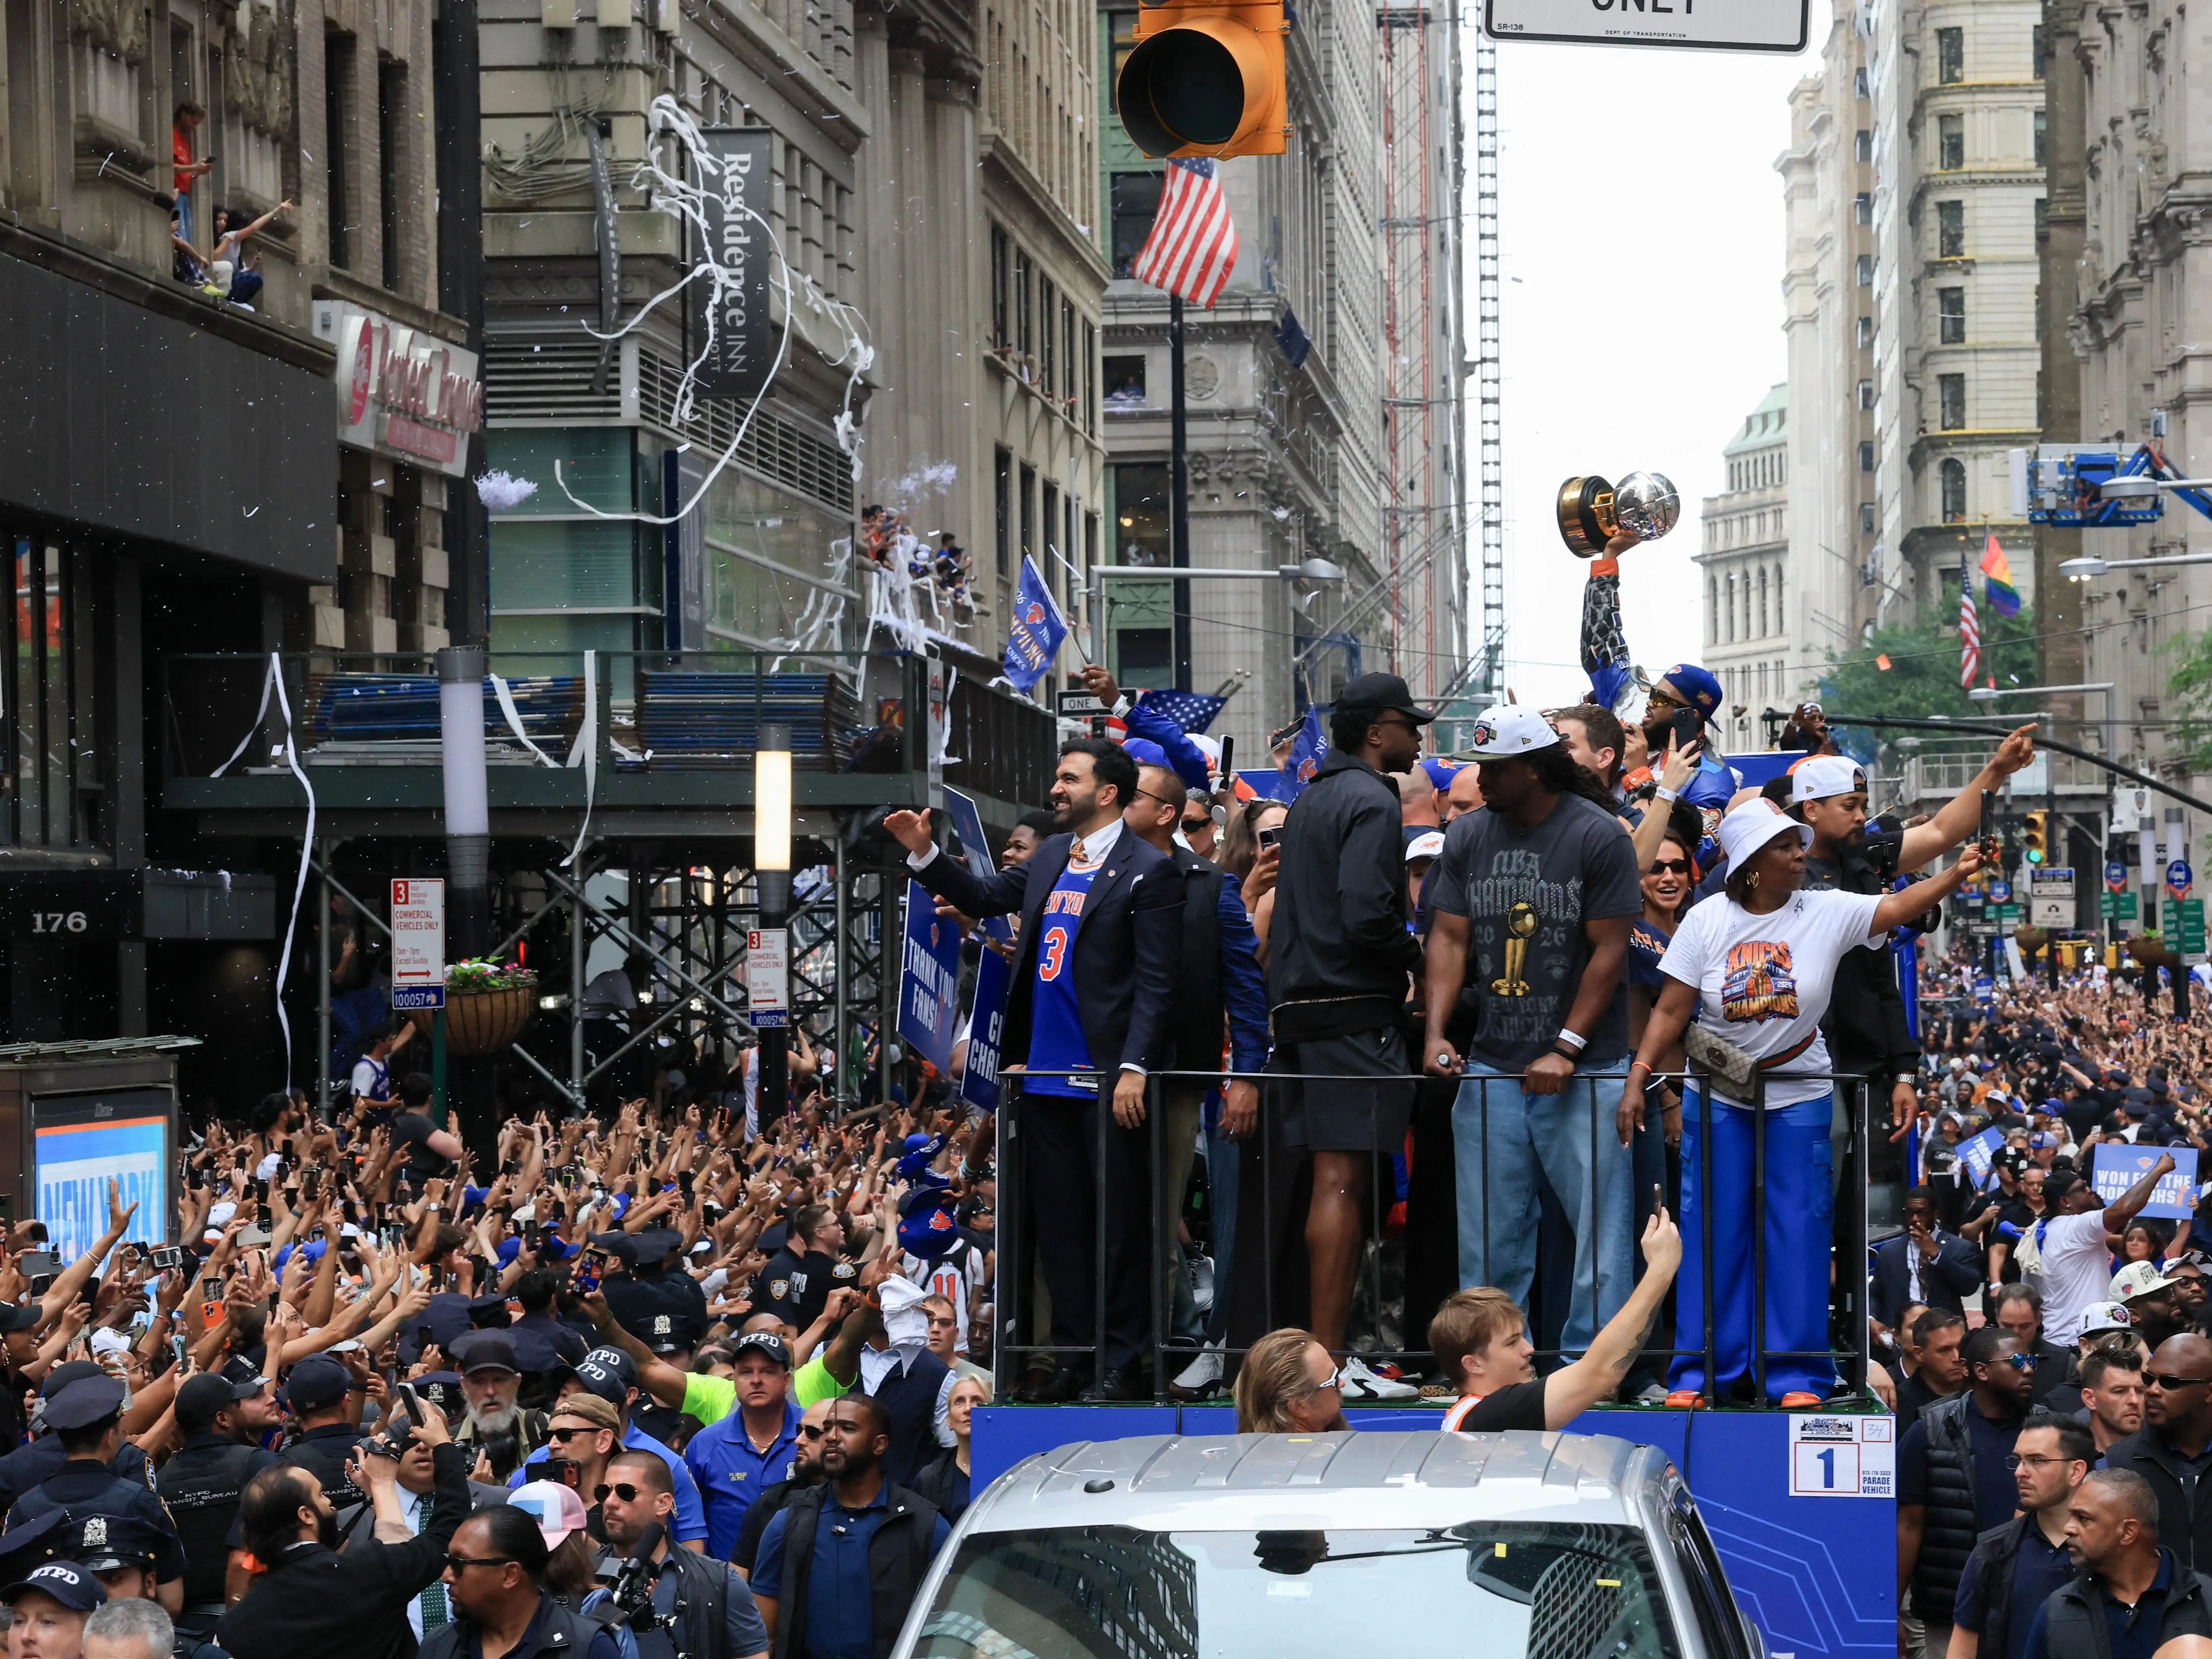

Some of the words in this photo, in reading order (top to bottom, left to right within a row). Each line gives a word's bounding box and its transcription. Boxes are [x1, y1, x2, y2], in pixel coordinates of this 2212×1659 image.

[724, 152, 751, 326] Residence
[726, 335, 747, 373] INN
[1069, 698, 1091, 709] ONE
[1314, 735, 1327, 755] NB
[1492, 849, 1542, 880] NBA
[397, 883, 405, 903] 3
[1043, 890, 1064, 915] EW
[1062, 890, 1087, 916] YO
[33, 912, 87, 933] 176
[396, 911, 433, 919] COMMERCIAL
[396, 922, 423, 930] VEHICLES
[424, 921, 439, 930] ONLY
[1475, 924, 1495, 945] 20
[1540, 926, 1567, 947] 26
[751, 933, 758, 948] 3
[1039, 927, 1068, 982] 3
[1725, 941, 1792, 977] KNICKS
[908, 937, 938, 993] THANK
[938, 965, 955, 1009] YOU
[1777, 981, 1793, 989] 2026
[395, 994, 425, 1007] 100057
[912, 983, 938, 1034] FANS!
[1723, 995, 1800, 1022] CHAMPIONS
[969, 1038, 1000, 1086] CHA
[2097, 1170, 2129, 1185] WON
[2164, 1174, 2191, 1190] THE
[739, 1333, 779, 1348] NYPD
[574, 1362, 606, 1380] YPD
[1816, 1448, 1834, 1488] 1
[166, 1497, 197, 1505] RANSIT
[201, 1491, 238, 1500] BUREAU
[26, 1566, 80, 1585] NYPD
